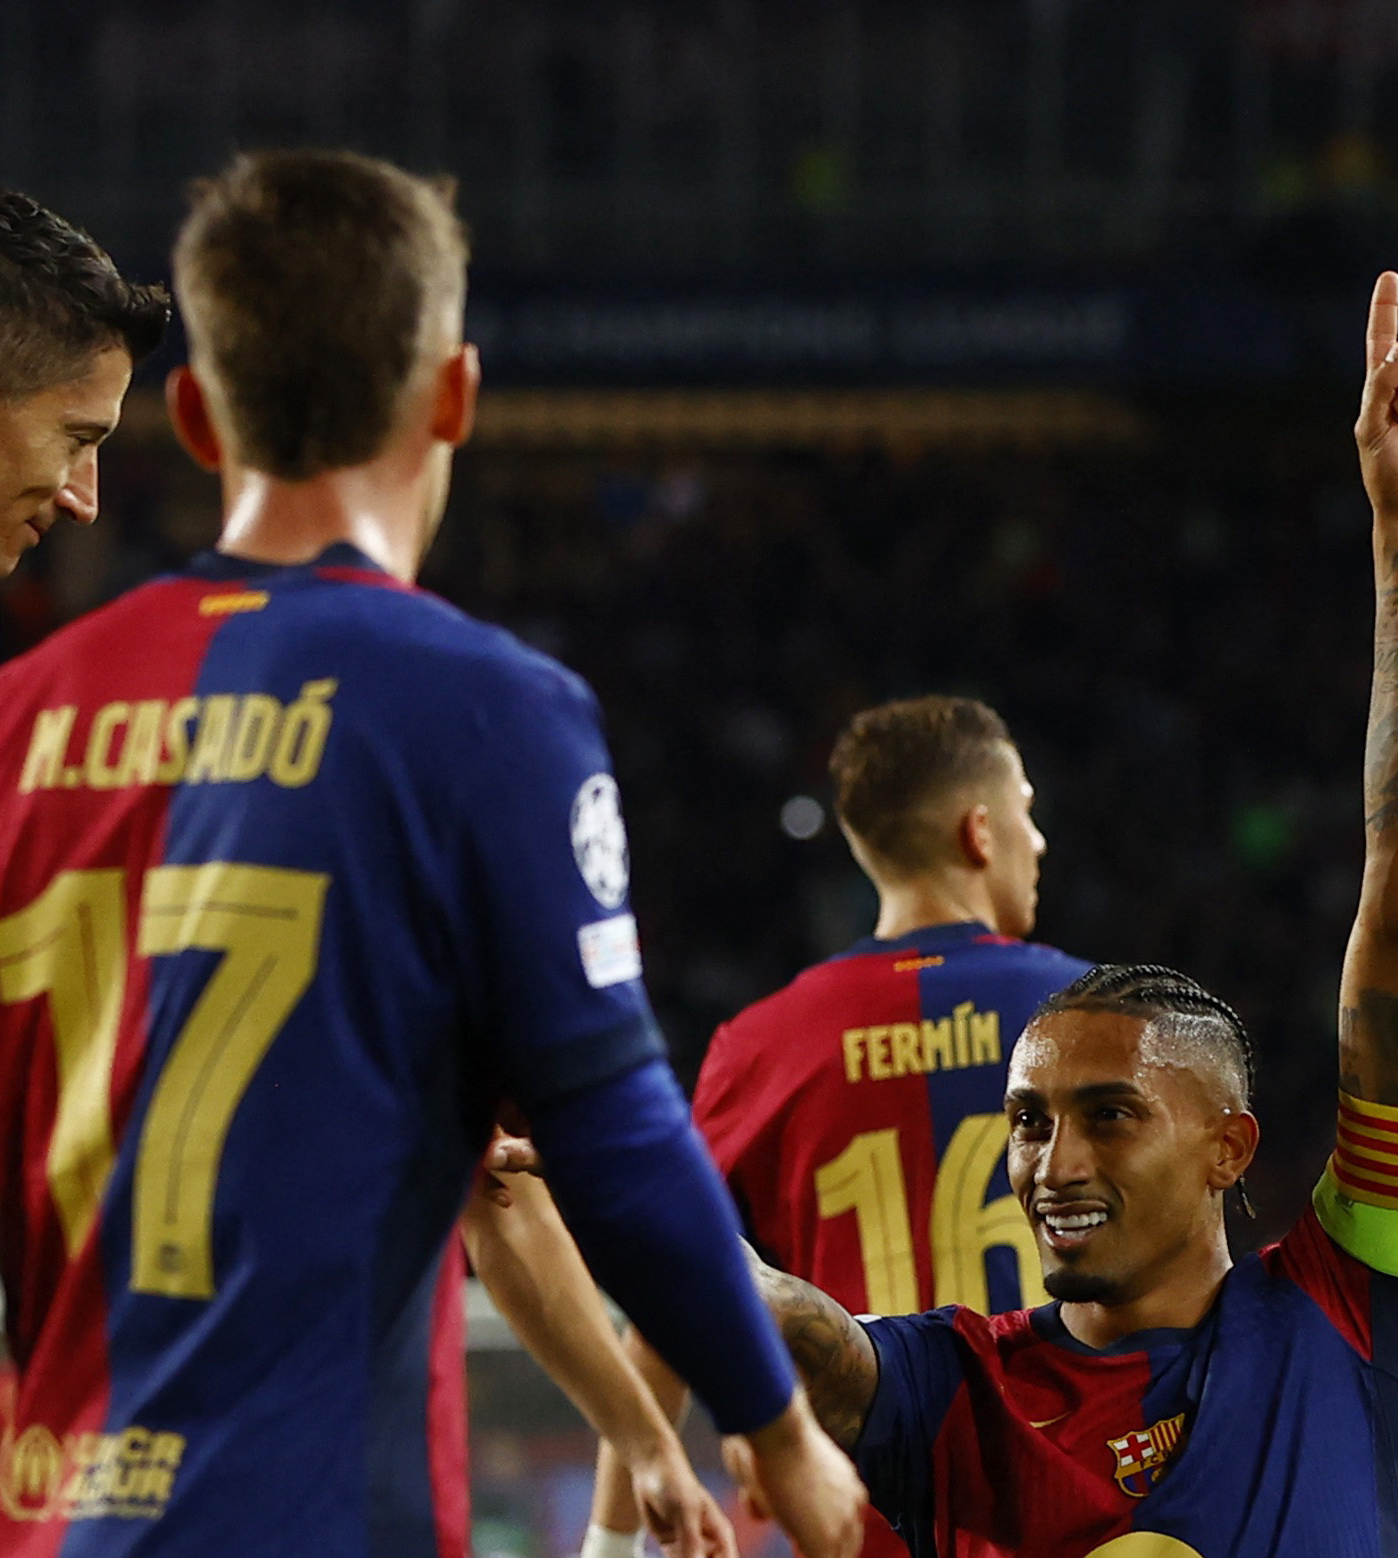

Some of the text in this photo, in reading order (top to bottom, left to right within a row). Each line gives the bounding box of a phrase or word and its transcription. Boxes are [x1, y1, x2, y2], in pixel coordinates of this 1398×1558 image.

[17, 677, 340, 796] M.CASADÓ
[842, 1001, 1002, 1083] FERMÍN
[814, 1112, 1056, 1317] 16
